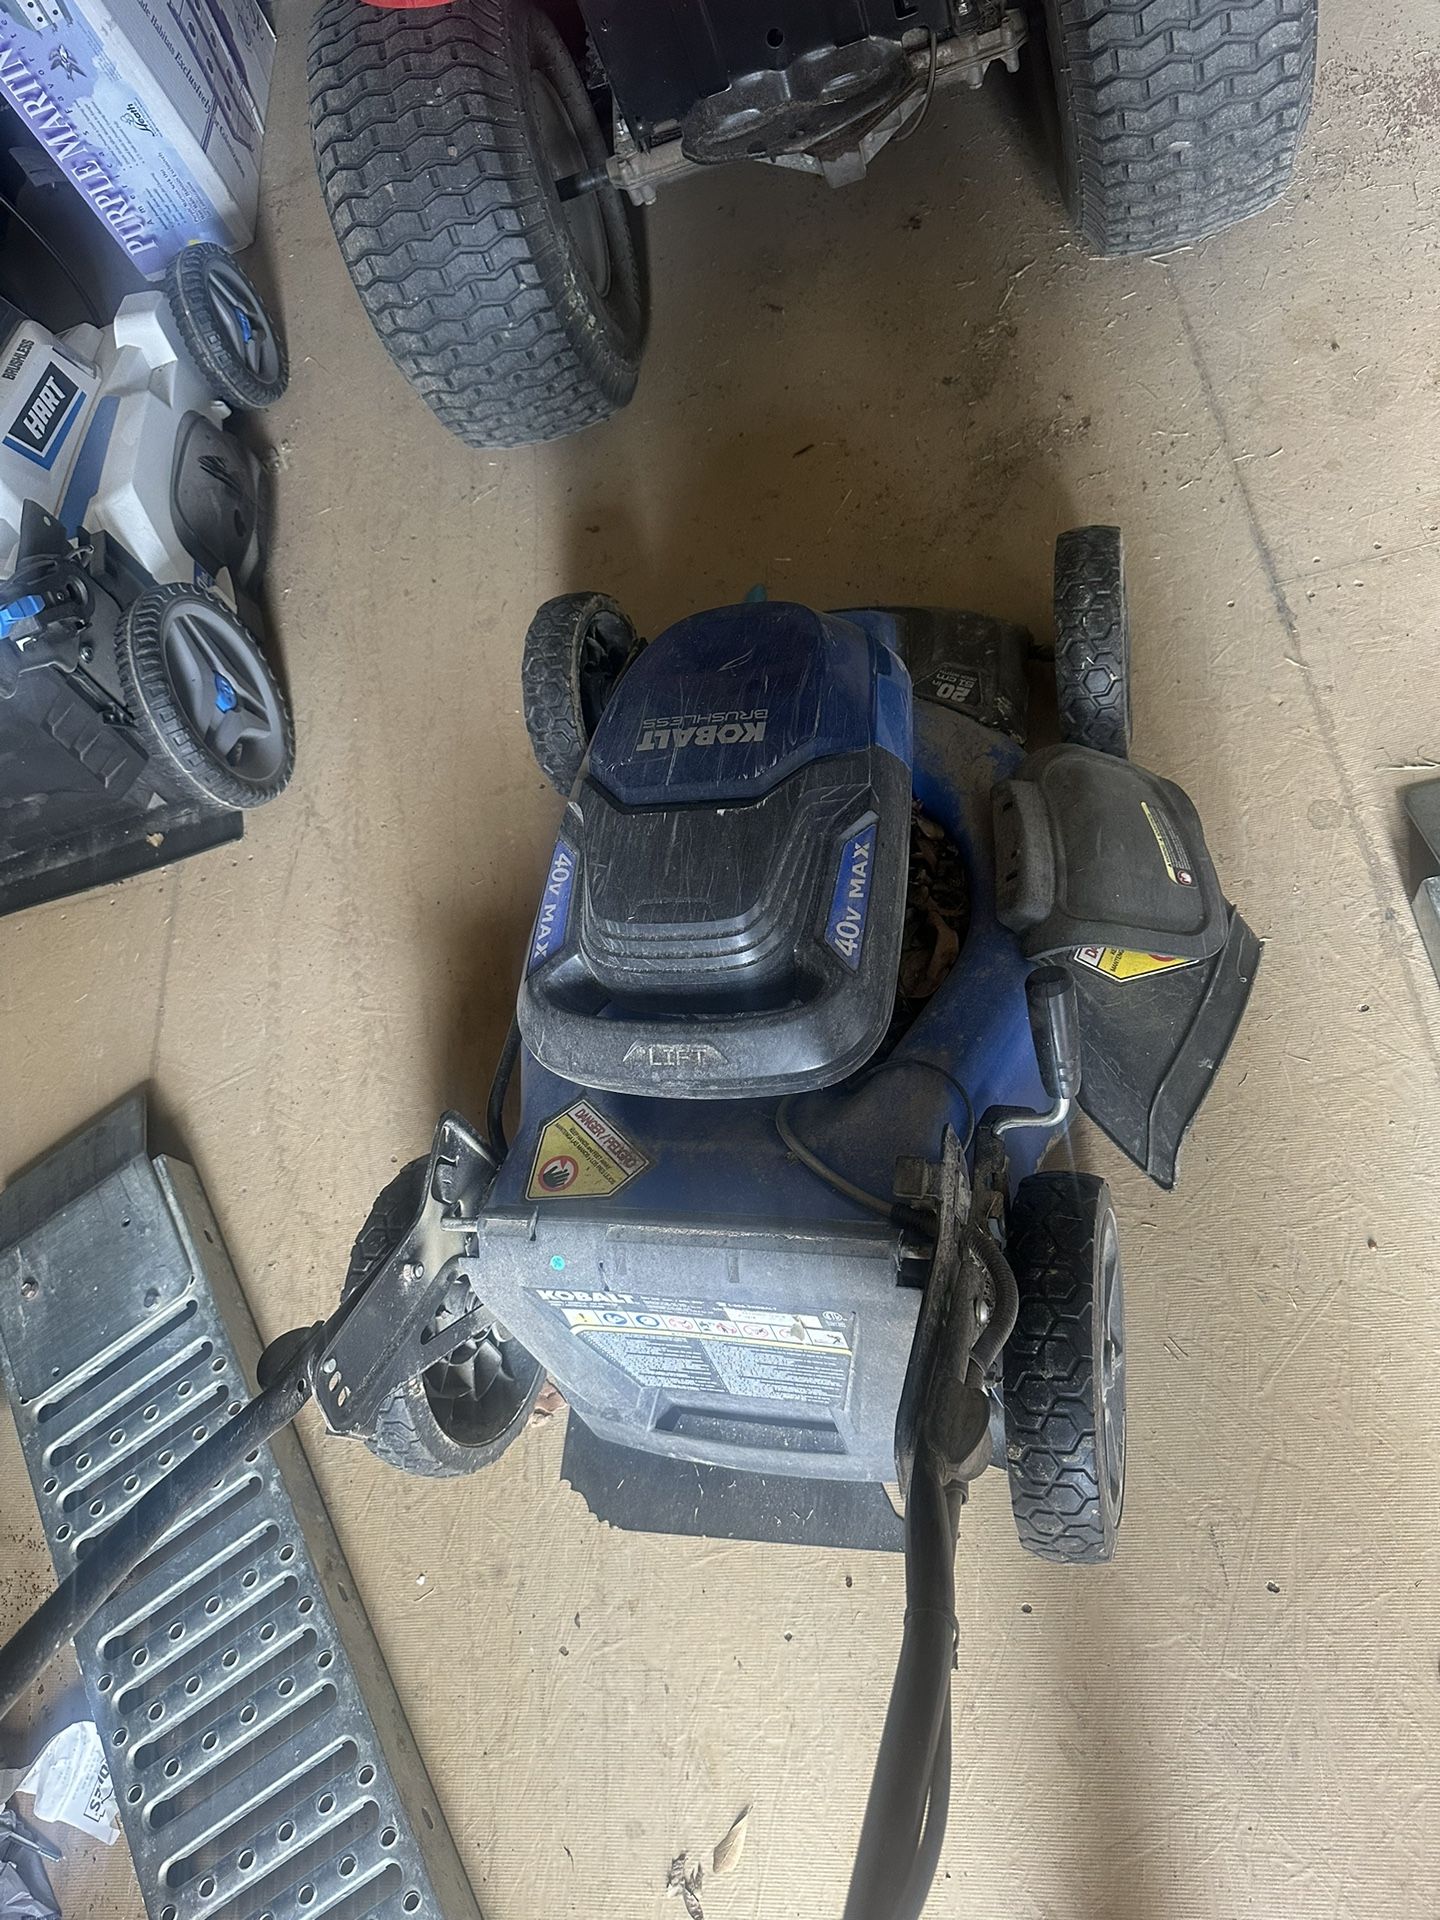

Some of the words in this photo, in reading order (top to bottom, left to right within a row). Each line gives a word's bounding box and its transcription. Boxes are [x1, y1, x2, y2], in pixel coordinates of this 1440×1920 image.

[1, 19, 73, 114] Favorite
[150, 15, 175, 55] Habitats
[174, 52, 211, 114] Exclusively
[127, 103, 155, 137] Heath
[83, 130, 154, 225] America's
[71, 158, 159, 255] PURPLE
[2, 339, 35, 380] BRUSHLESS
[22, 375, 66, 440] HART
[936, 673, 957, 682] cm
[936, 682, 971, 702] 20
[959, 679, 974, 688] 51
[636, 721, 766, 752] KOBALT
[642, 708, 769, 730] BRUSHLESS
[848, 841, 871, 900] MAX
[531, 902, 558, 960] MAX
[648, 1044, 709, 1067] LIFT
[574, 1108, 606, 1137] DANGER
[603, 1136, 637, 1169] PELIGRO
[536, 1289, 634, 1304] KOBALT
